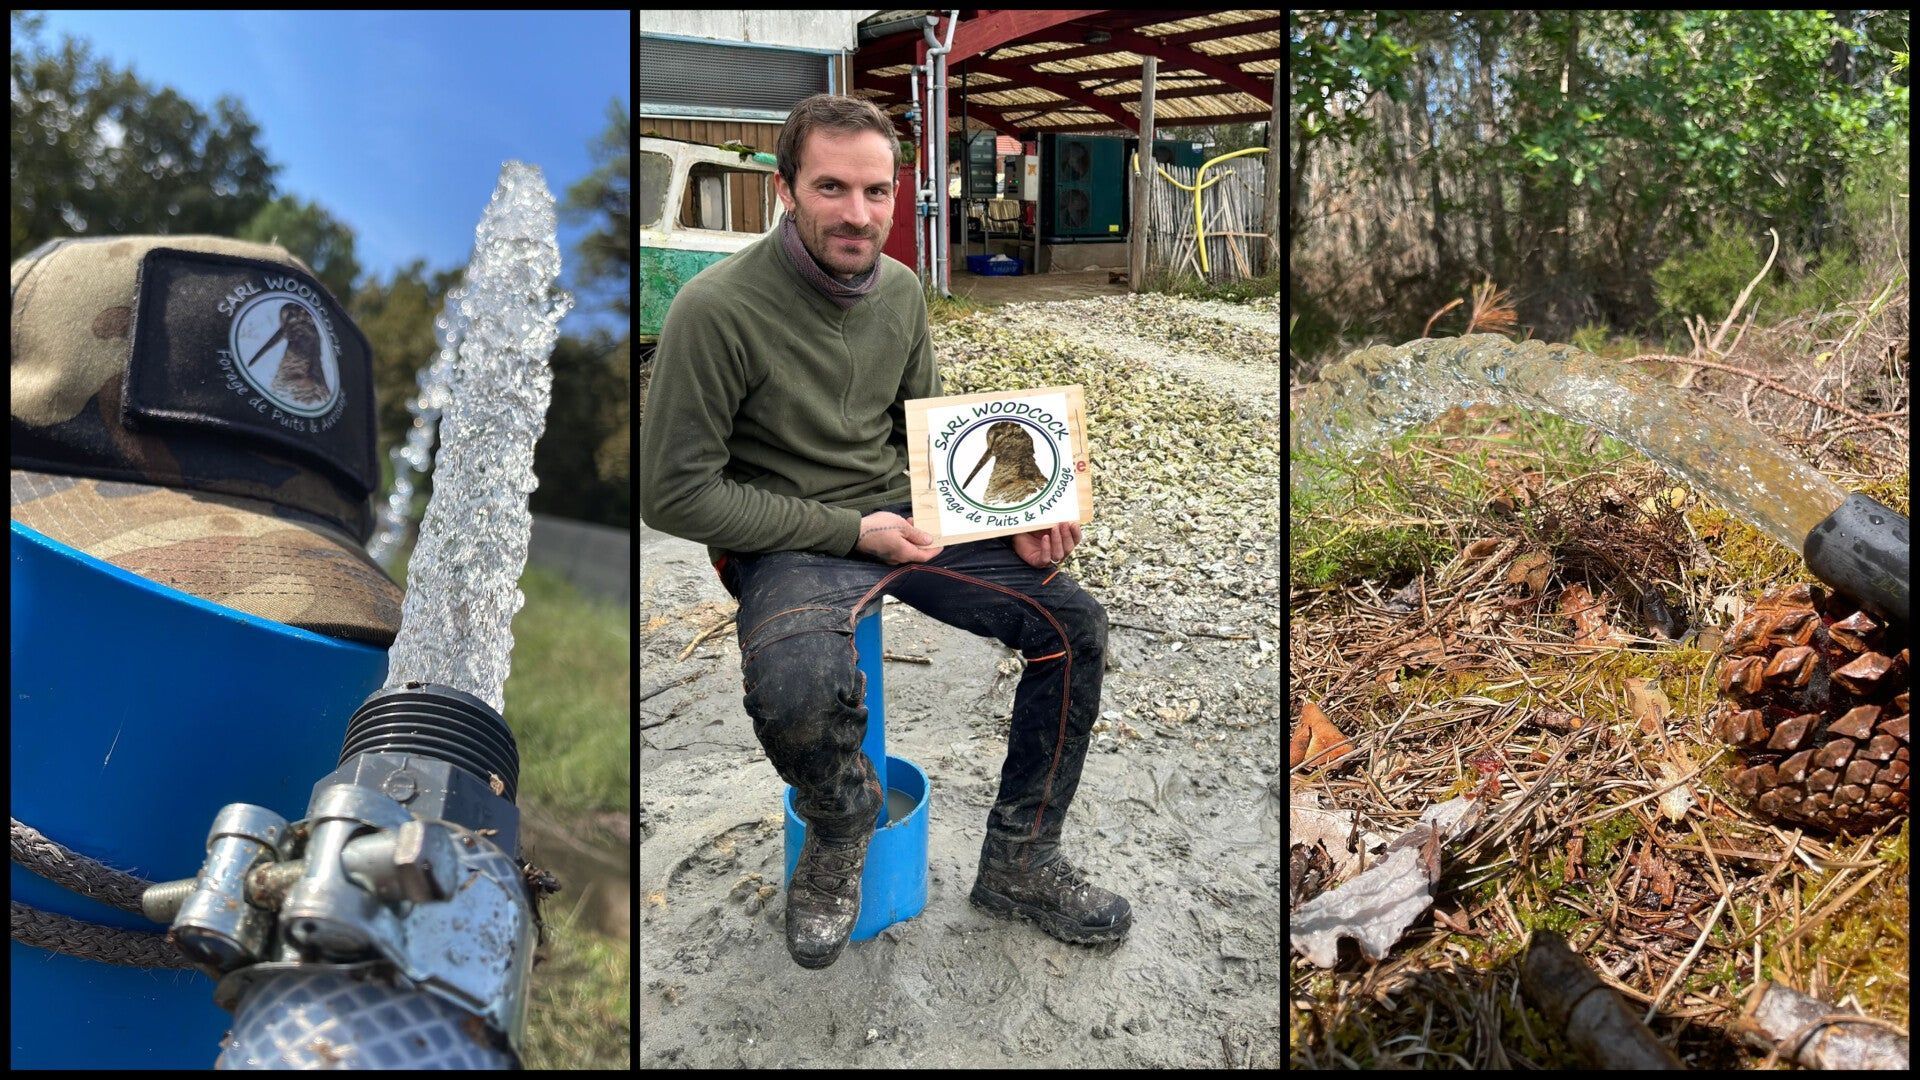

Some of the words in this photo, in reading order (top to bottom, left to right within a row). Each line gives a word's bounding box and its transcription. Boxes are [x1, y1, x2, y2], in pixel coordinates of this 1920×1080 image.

[217, 281, 262, 317] SARL
[264, 276, 342, 356] WOODCOCK
[217, 350, 249, 396] Forage
[248, 397, 268, 414] de
[272, 410, 305, 432] Puits
[935, 415, 970, 451] SARL
[972, 401, 1069, 441] WOODCOCK
[936, 479, 965, 514] Forage
[965, 510, 982, 523] de
[986, 514, 1019, 527] Puits
[1024, 511, 1036, 523] &
[1038, 466, 1074, 515] Arrosage
